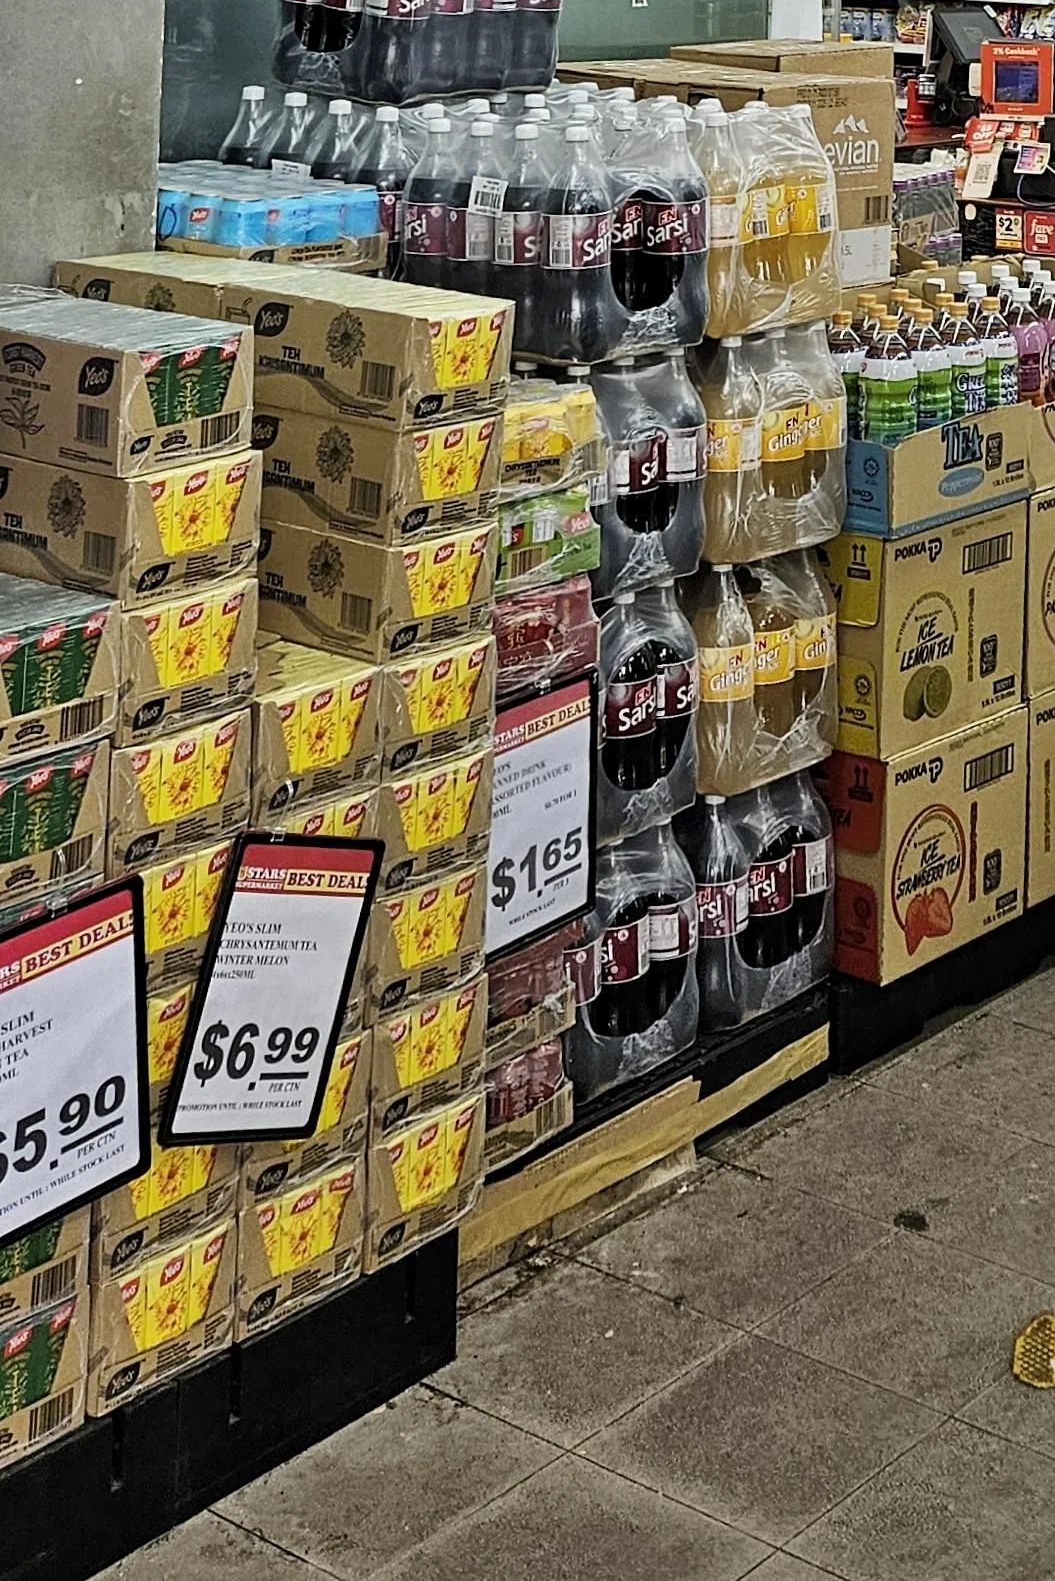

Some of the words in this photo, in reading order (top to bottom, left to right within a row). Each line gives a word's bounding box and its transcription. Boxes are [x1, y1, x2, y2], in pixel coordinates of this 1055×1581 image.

[825, 136, 881, 165] evian
[646, 213, 688, 247] Sarsi
[259, 308, 284, 328] Yeo's
[281, 345, 301, 361] TEH
[84, 367, 109, 388] Yeo's
[418, 401, 439, 416] Yeo's
[941, 421, 984, 470] TEA
[273, 458, 291, 474] TEH
[4, 513, 23, 529] TEH
[894, 543, 927, 561] POKKA
[142, 568, 166, 587] Yeo's
[265, 572, 284, 588] TEH
[182, 607, 201, 625] Yeo's
[917, 619, 938, 640] ICE
[900, 644, 936, 672] LEMON
[936, 635, 955, 656] TEA
[527, 713, 555, 737] BEST
[895, 764, 928, 786] POKKA
[920, 838, 941, 867] ICE
[246, 867, 287, 881] STARS
[491, 826, 582, 912] $1.65
[895, 864, 945, 900] STRAWBERRY
[945, 854, 961, 877] TEA
[287, 871, 325, 887] BEST
[225, 922, 255, 935] YEO'S
[256, 923, 282, 935] SLIM
[301, 941, 318, 951] TEA
[25, 942, 73, 974] BEST
[255, 955, 289, 966] MELON
[7, 1048, 29, 1066] TEA
[193, 1019, 320, 1091] $6.99
[268, 1082, 284, 1092] PER
[284, 1081, 301, 1092] CTN
[177, 1103, 218, 1113] PROMOTION
[242, 1101, 264, 1111] WHILE
[265, 1100, 285, 1110] STOCK
[286, 1099, 302, 1109] LAST
[77, 1142, 96, 1159] PER
[97, 1132, 116, 1152] CTN
[19, 1186, 44, 1206] UNTIL
[50, 1170, 77, 1189] WHILE
[77, 1156, 104, 1176] STOCK
[106, 1144, 126, 1163] LAST
[164, 1261, 183, 1279] Yeo's
